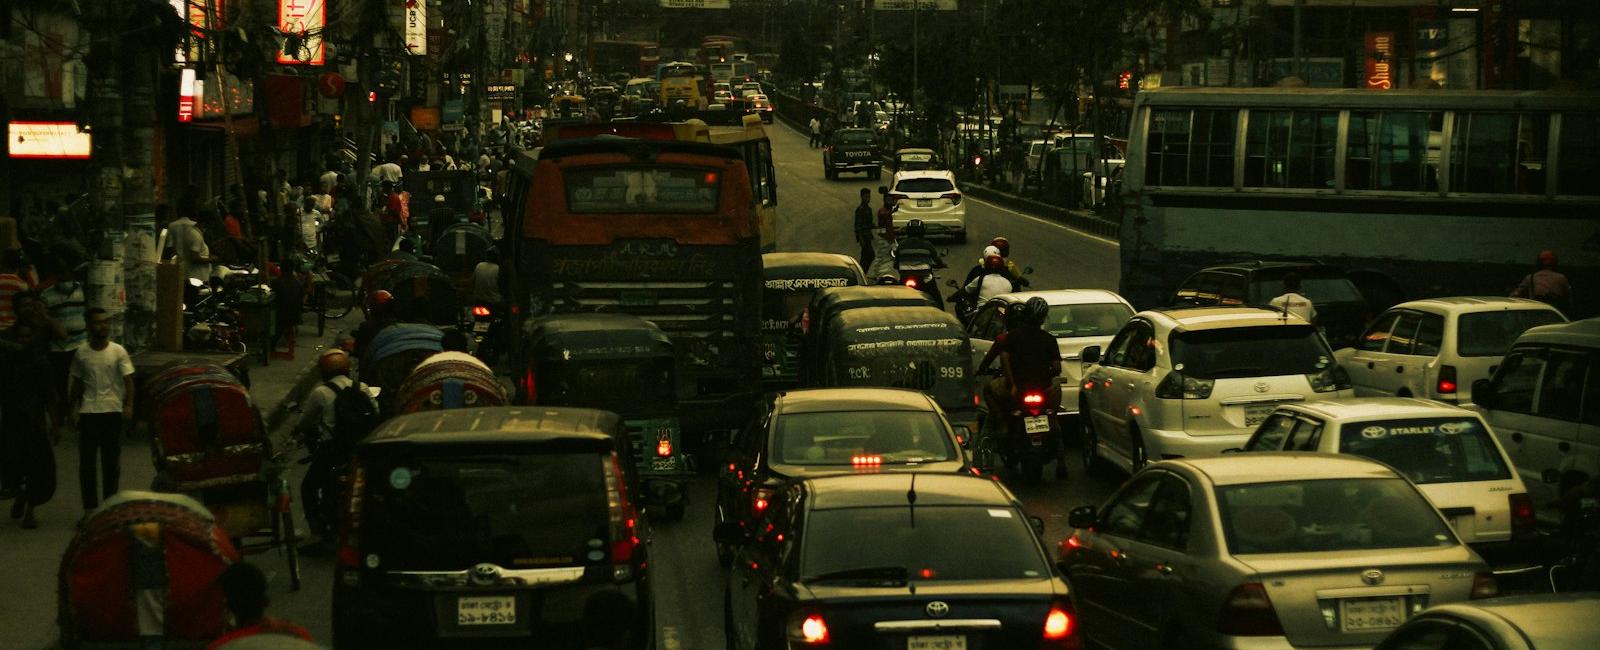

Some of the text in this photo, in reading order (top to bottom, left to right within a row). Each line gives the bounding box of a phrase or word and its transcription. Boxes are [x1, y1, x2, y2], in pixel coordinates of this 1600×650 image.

[409, 10, 417, 28] UCB
[1368, 36, 1392, 90] Shwpno
[939, 367, 963, 379] 999
